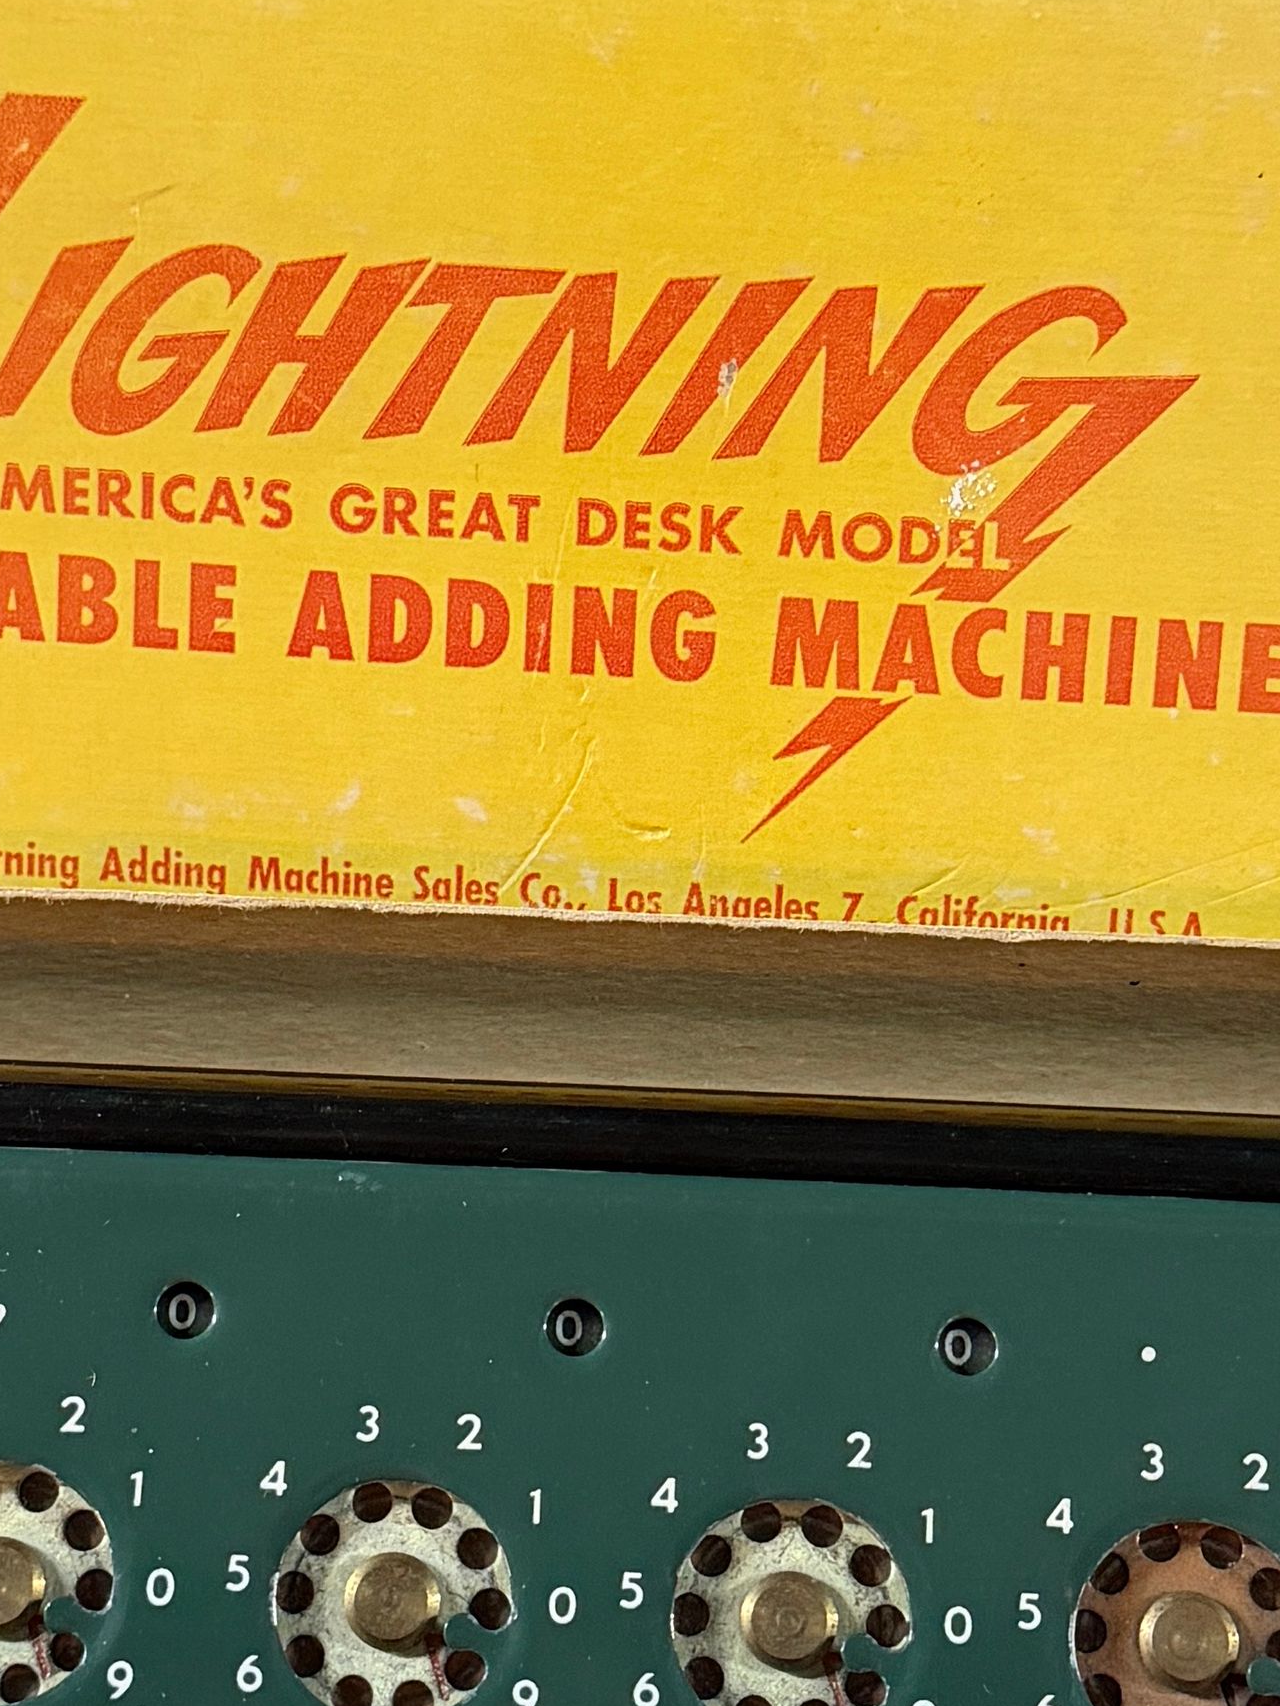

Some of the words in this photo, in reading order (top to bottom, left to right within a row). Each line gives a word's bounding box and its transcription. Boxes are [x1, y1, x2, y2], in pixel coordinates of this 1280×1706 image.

[329, 484, 541, 543] GREAT
[576, 498, 743, 554] DESK
[778, 509, 1014, 572] MODEL
[286, 570, 716, 683] ADDING
[100, 847, 225, 894] Adding
[248, 856, 393, 898] Machine
[415, 865, 498, 905] Sales
[608, 879, 660, 913] Los
[168, 1293, 196, 1330] 0
[555, 1310, 582, 1346] 0
[944, 1329, 972, 1366] 0
[59, 1395, 86, 1433] 2
[355, 1405, 380, 1443] 3
[456, 1413, 483, 1451] 2
[746, 1422, 769, 1460] 3
[846, 1431, 872, 1469] 2
[259, 1460, 288, 1497] 4
[1140, 1442, 1164, 1481] 3
[1242, 1452, 1270, 1491] 2
[130, 1470, 144, 1507] 1
[529, 1488, 542, 1525] 1
[650, 1477, 679, 1514] 4
[921, 1507, 934, 1544] 1
[1045, 1497, 1074, 1535] 4
[145, 1567, 175, 1607] 0
[225, 1554, 250, 1592] 5
[619, 1571, 644, 1609] 5
[548, 1586, 577, 1625] 0
[1017, 1592, 1042, 1631] 5
[944, 1605, 973, 1645] 0
[106, 1660, 134, 1700] 9
[236, 1654, 263, 1693] 6
